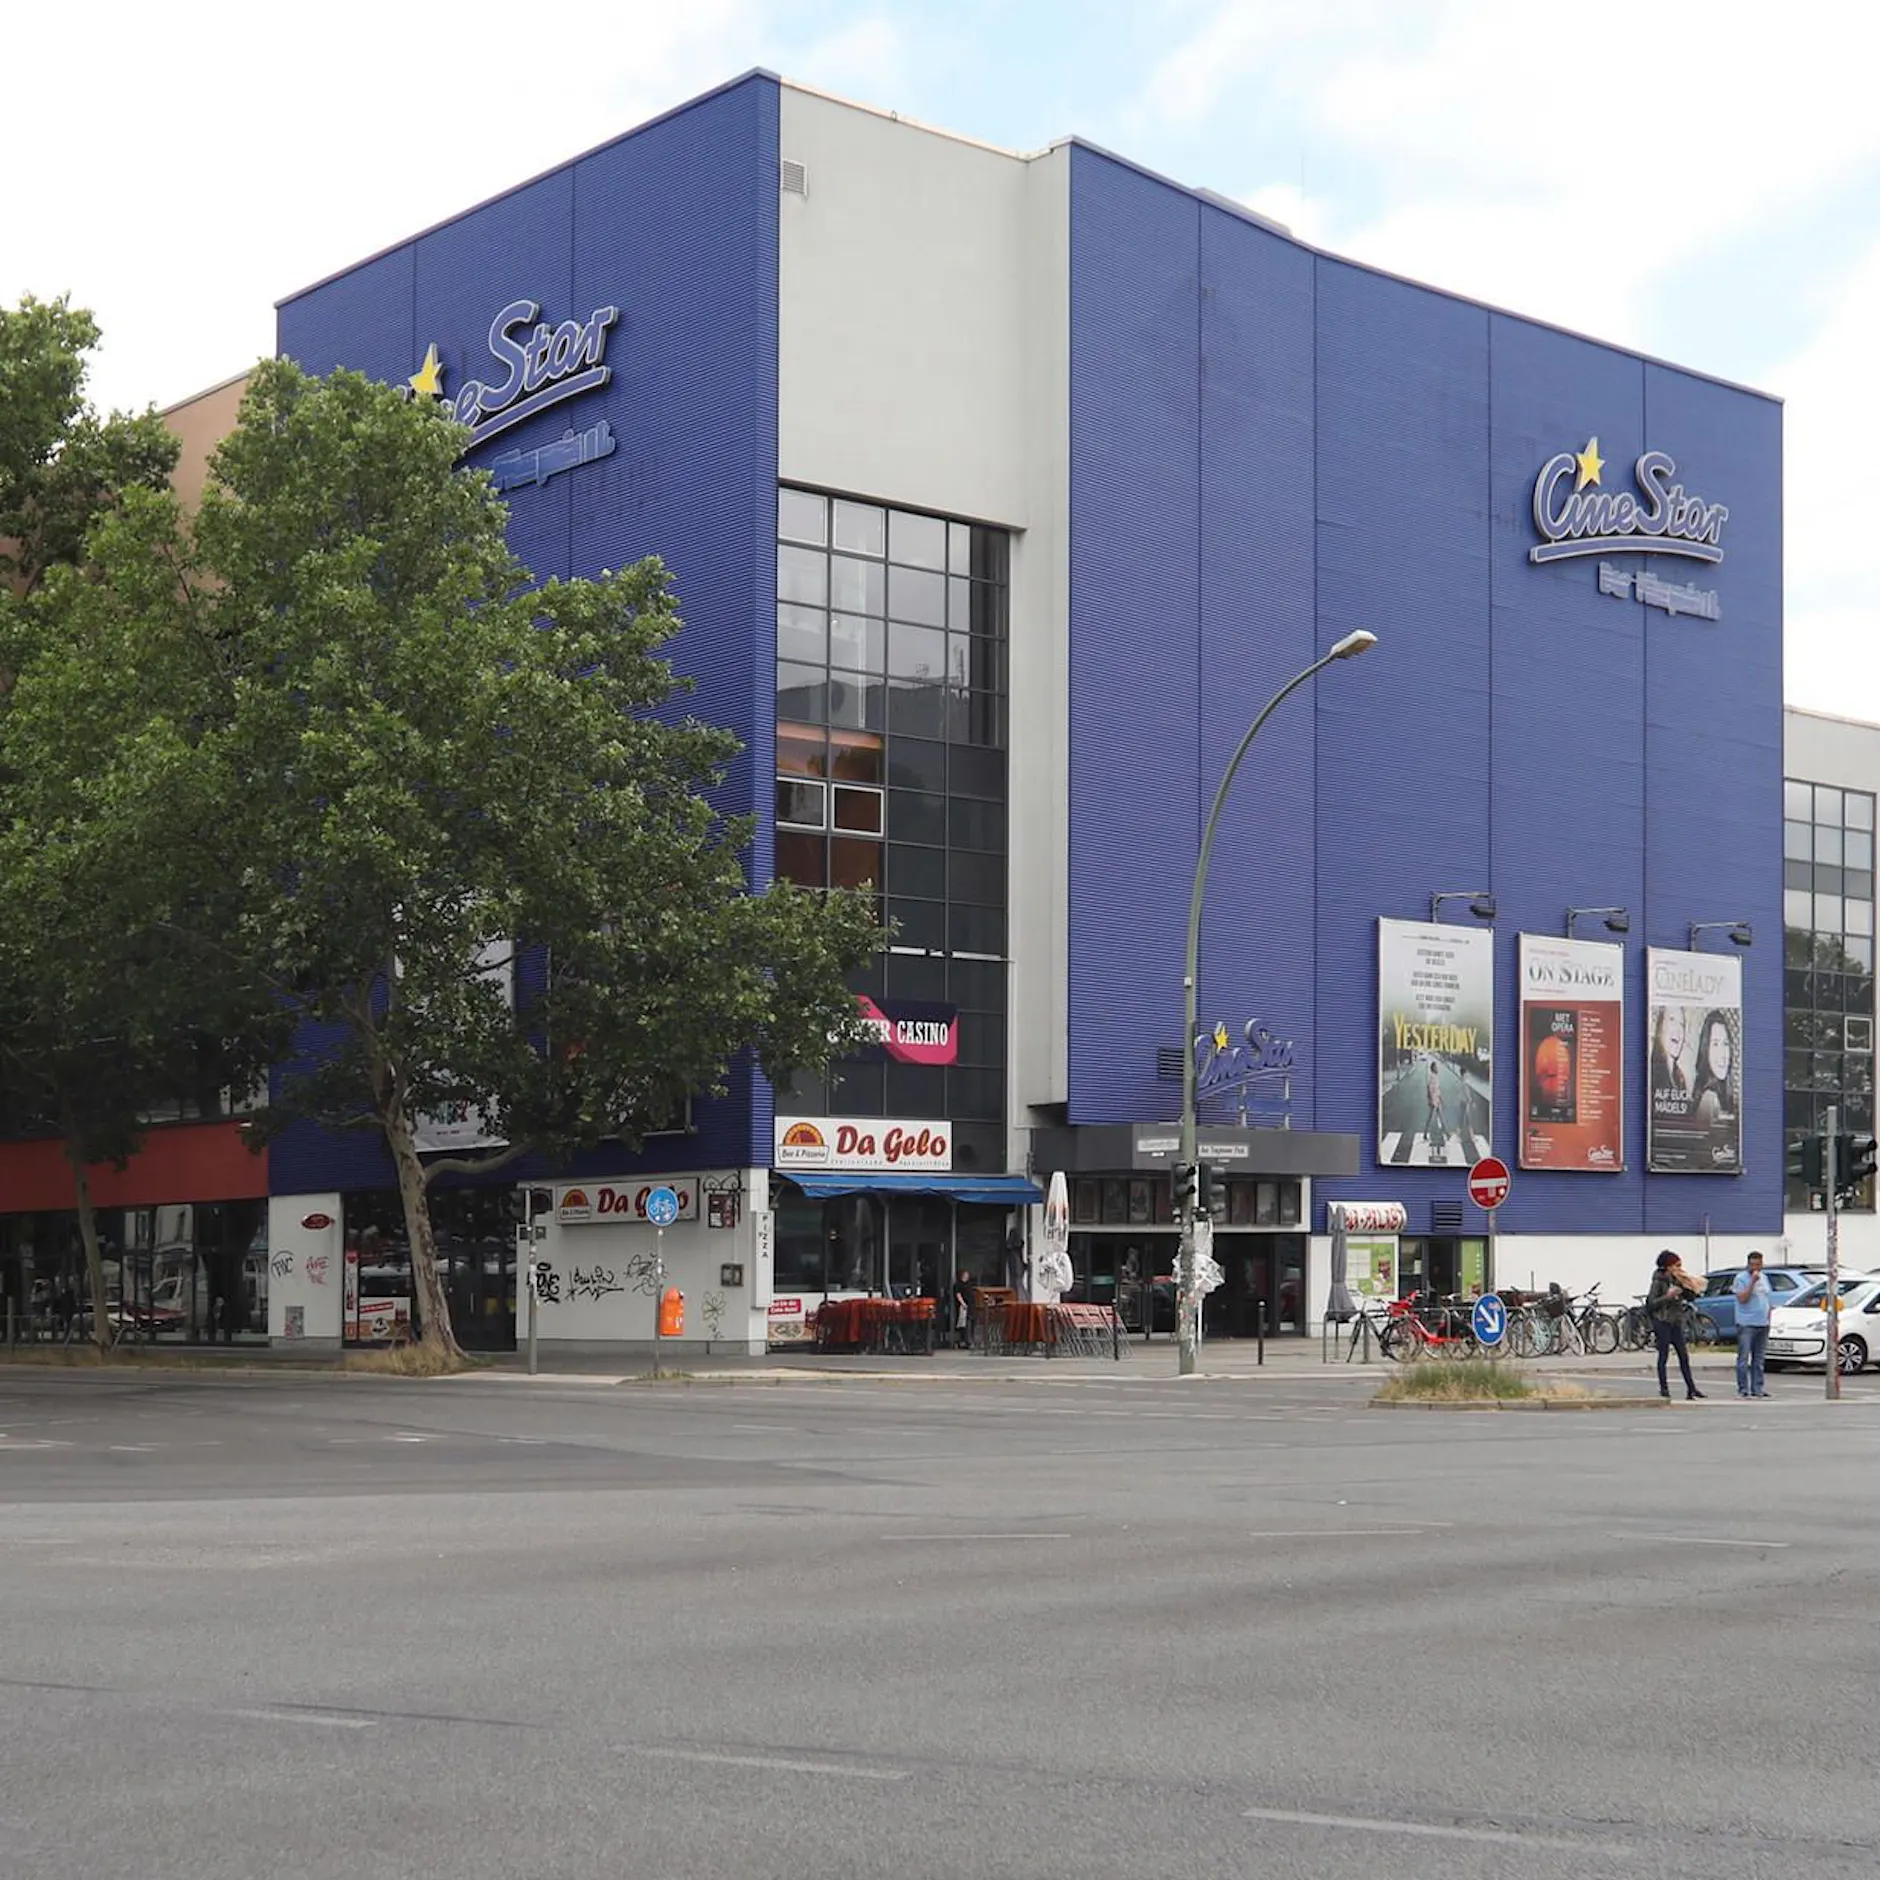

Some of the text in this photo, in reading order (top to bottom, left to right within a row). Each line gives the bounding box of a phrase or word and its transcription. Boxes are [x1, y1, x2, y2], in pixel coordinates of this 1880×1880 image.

[397, 300, 618, 427] eStar
[1533, 449, 1729, 544] CineStar
[1528, 960, 1615, 988] ON STAGE
[897, 1020, 948, 1046] CASINO
[1393, 1012, 1477, 1055] YESTERDAY
[836, 1125, 947, 1163] Da Gelo
[597, 1187, 629, 1214] Da
[635, 1184, 689, 1218] Go
